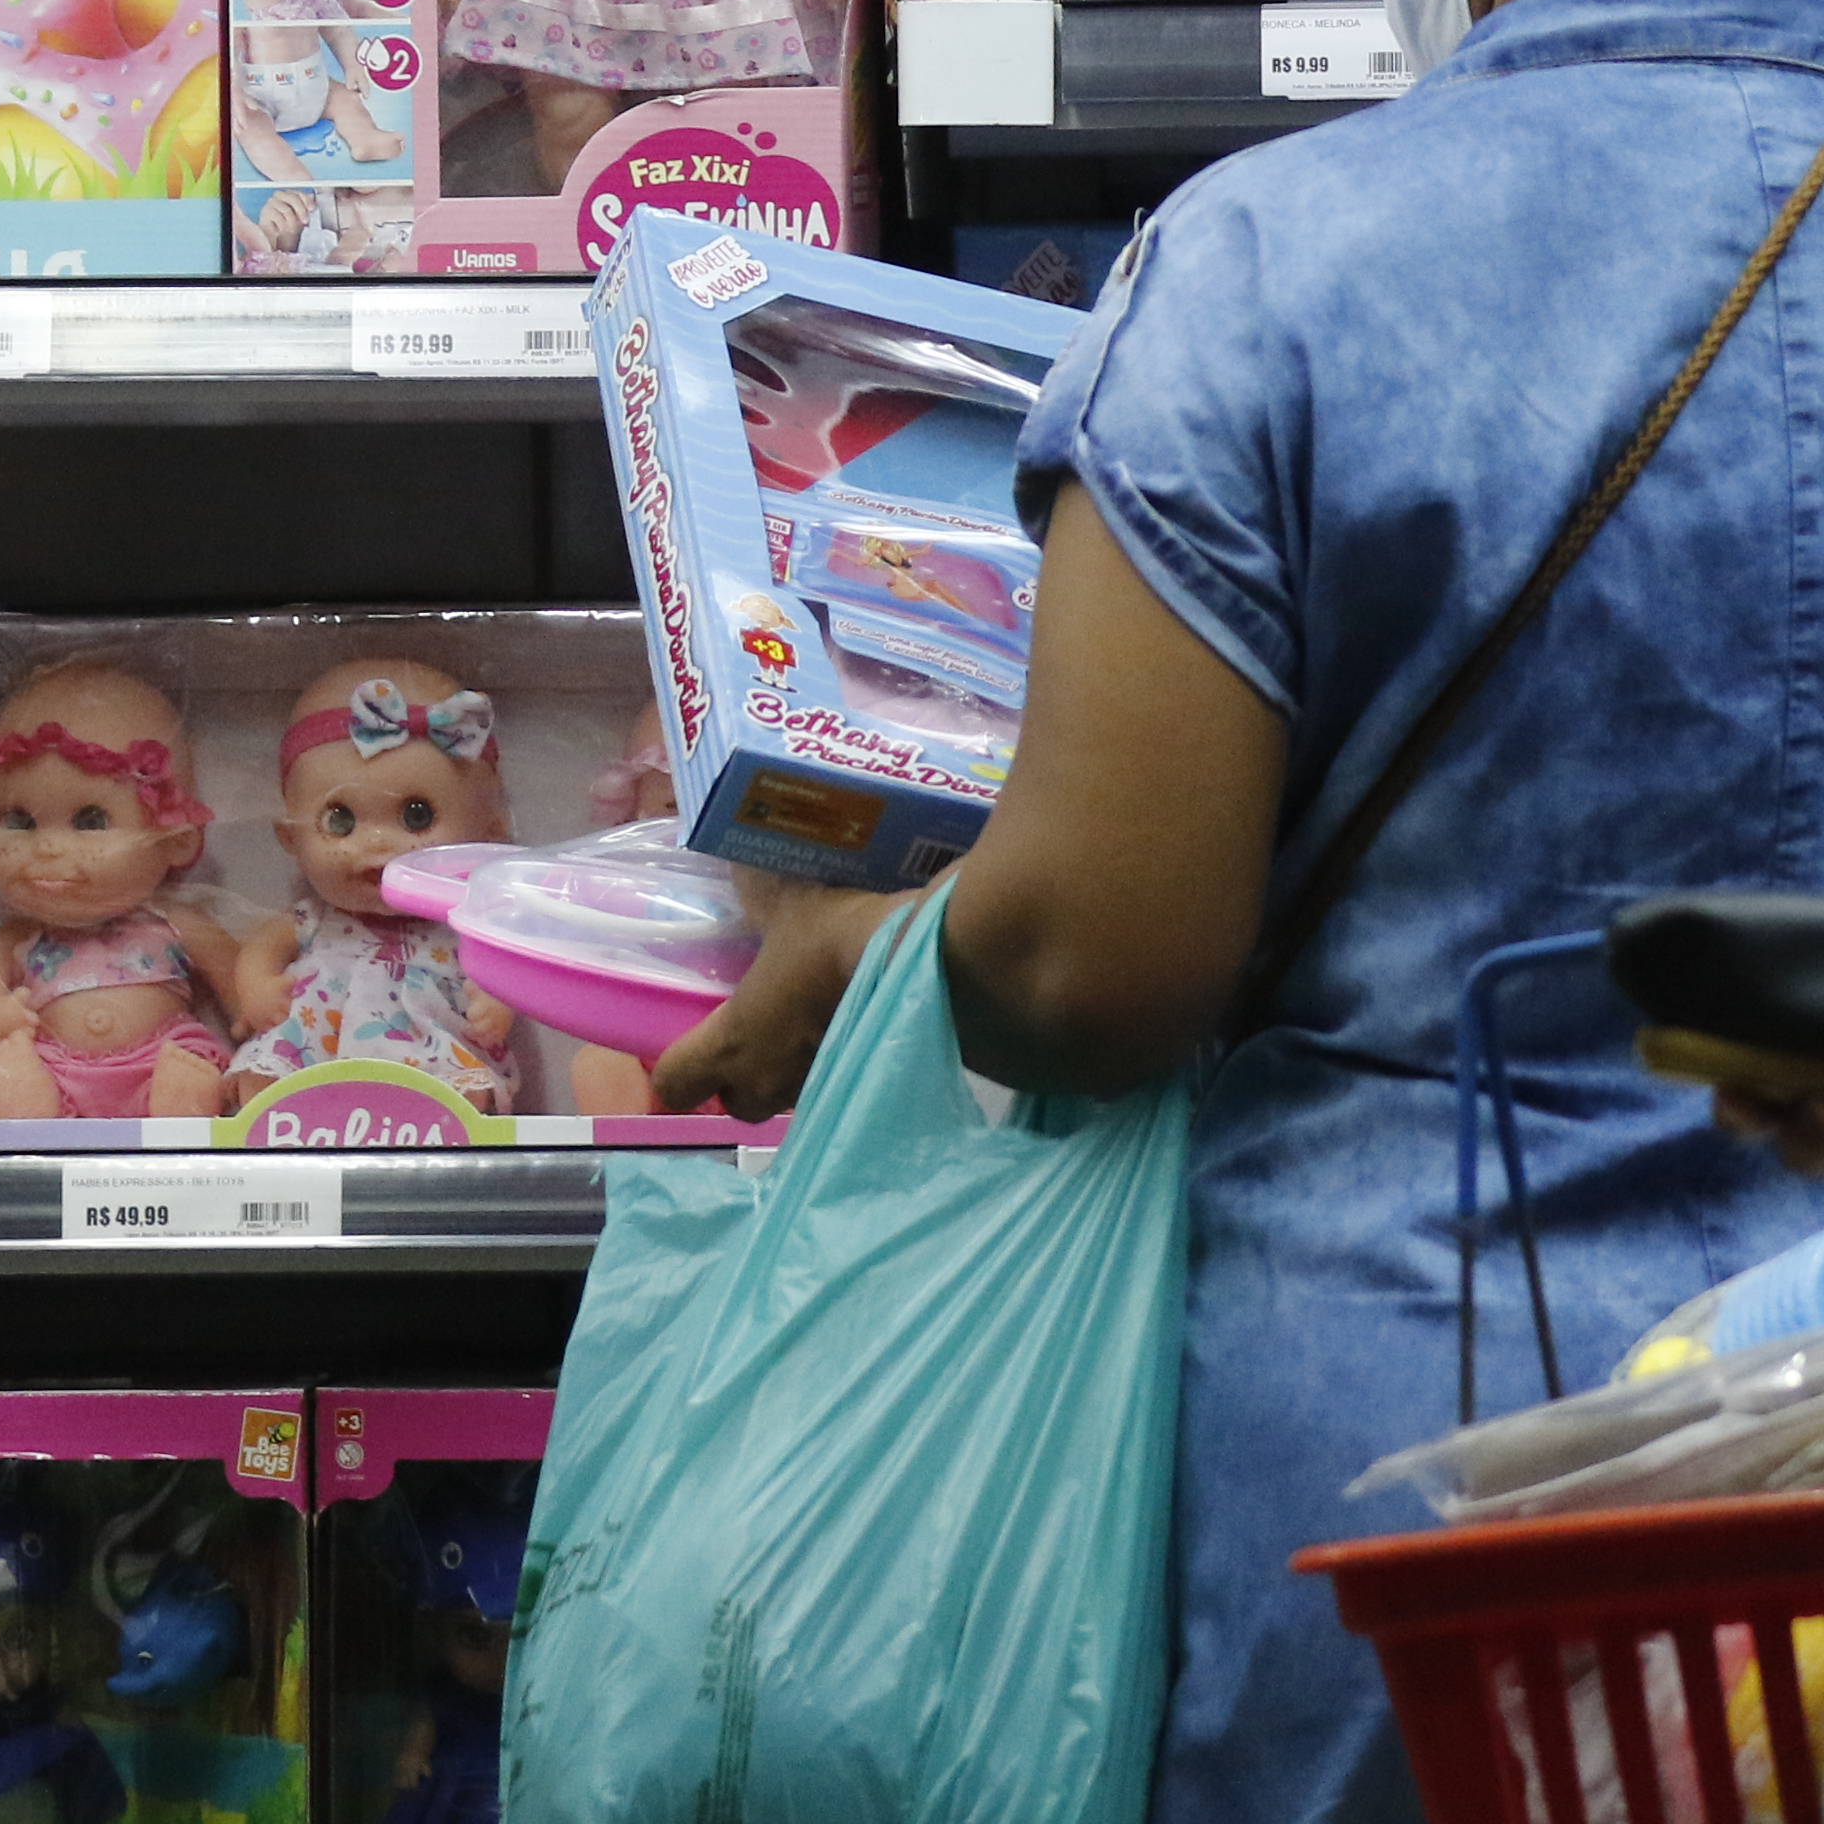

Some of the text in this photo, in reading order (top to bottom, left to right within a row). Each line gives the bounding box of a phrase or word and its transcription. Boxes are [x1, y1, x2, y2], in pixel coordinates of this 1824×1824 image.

[391, 52, 412, 79] 2
[1272, 57, 1329, 74] R$ 9,99
[629, 155, 751, 187] Faz Xixi
[454, 250, 516, 267] Vamos
[673, 241, 742, 285] APROVEITE
[693, 264, 762, 303] o verão
[371, 334, 453, 354] R$ 29,99
[617, 323, 656, 502] Bethany
[753, 639, 785, 661] +3
[747, 692, 917, 766] Bethany
[790, 736, 916, 782] Piscina
[86, 1206, 168, 1227] R$ 49,99
[337, 1415, 361, 1432] +3
[259, 1436, 289, 1457] Bee
[244, 1447, 287, 1473] Toys
